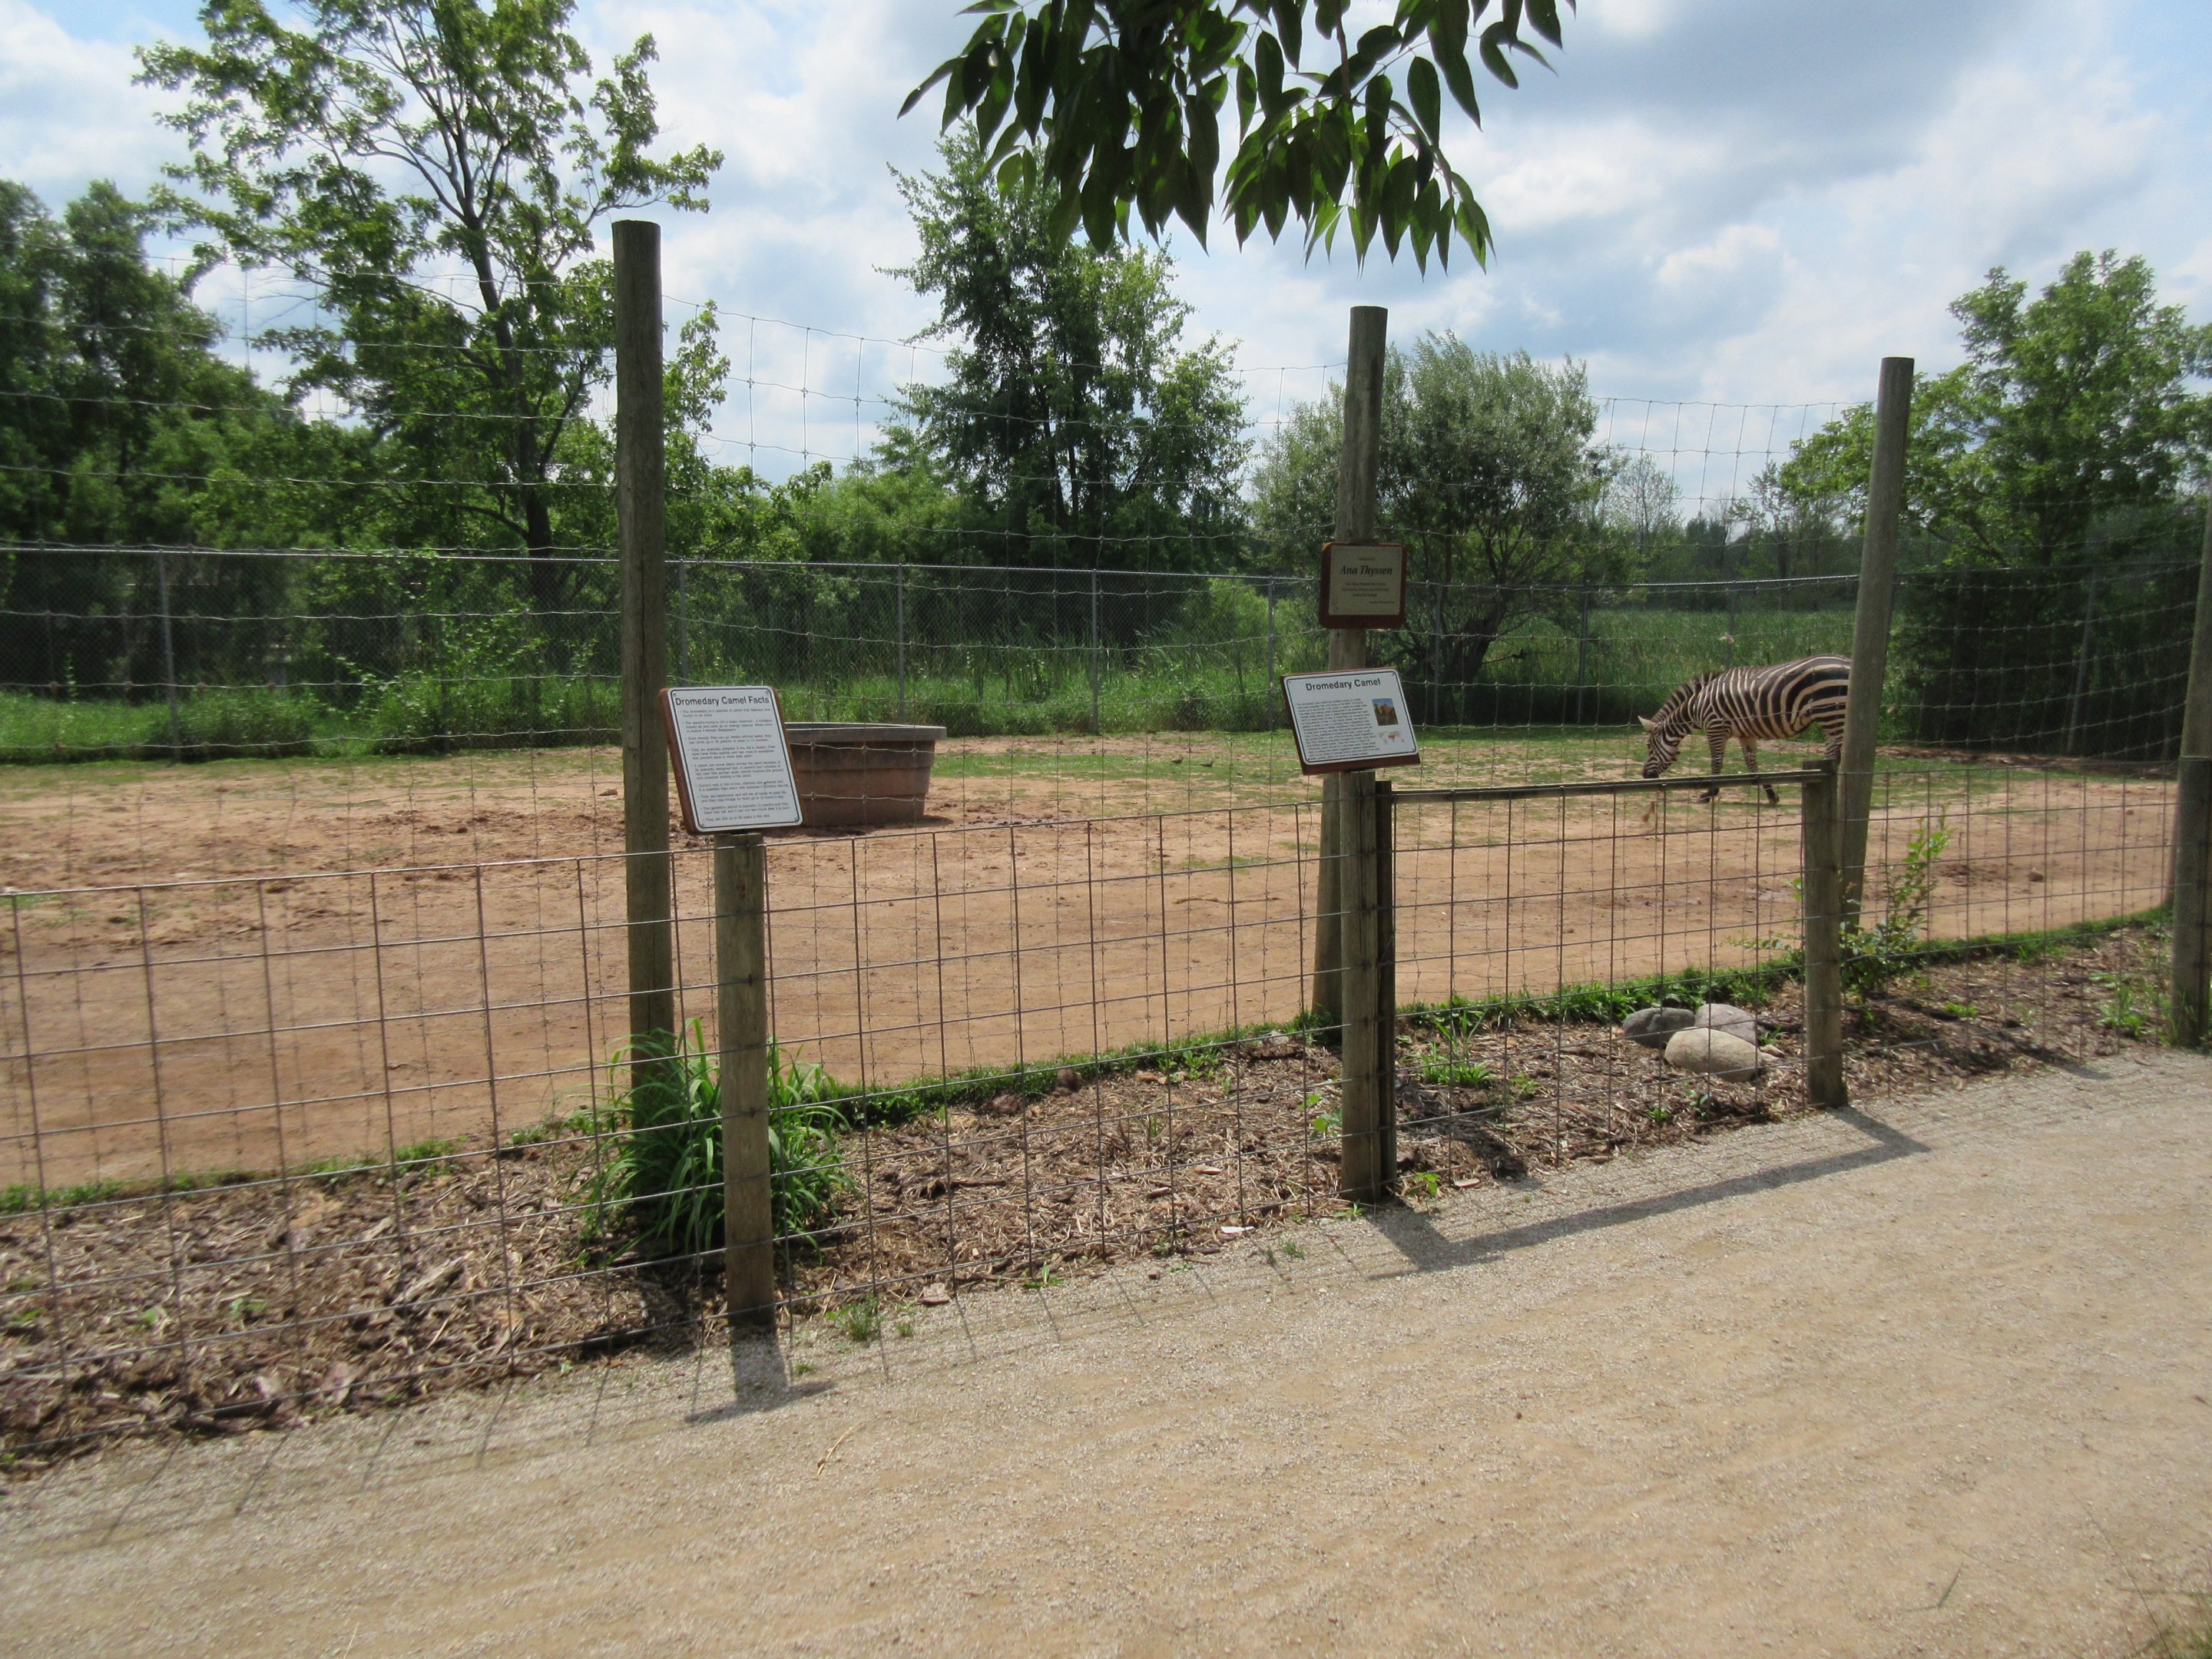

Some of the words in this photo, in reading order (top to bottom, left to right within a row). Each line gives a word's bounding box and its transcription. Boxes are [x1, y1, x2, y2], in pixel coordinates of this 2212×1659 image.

[1339, 565, 1357, 575] Ana
[1359, 565, 1392, 577] Thyssen
[1306, 680, 1352, 691] Dromedary
[1354, 678, 1381, 687] Camel
[675, 697, 720, 707] Dromedary
[721, 696, 747, 704] Camel
[749, 696, 770, 704] Facts
